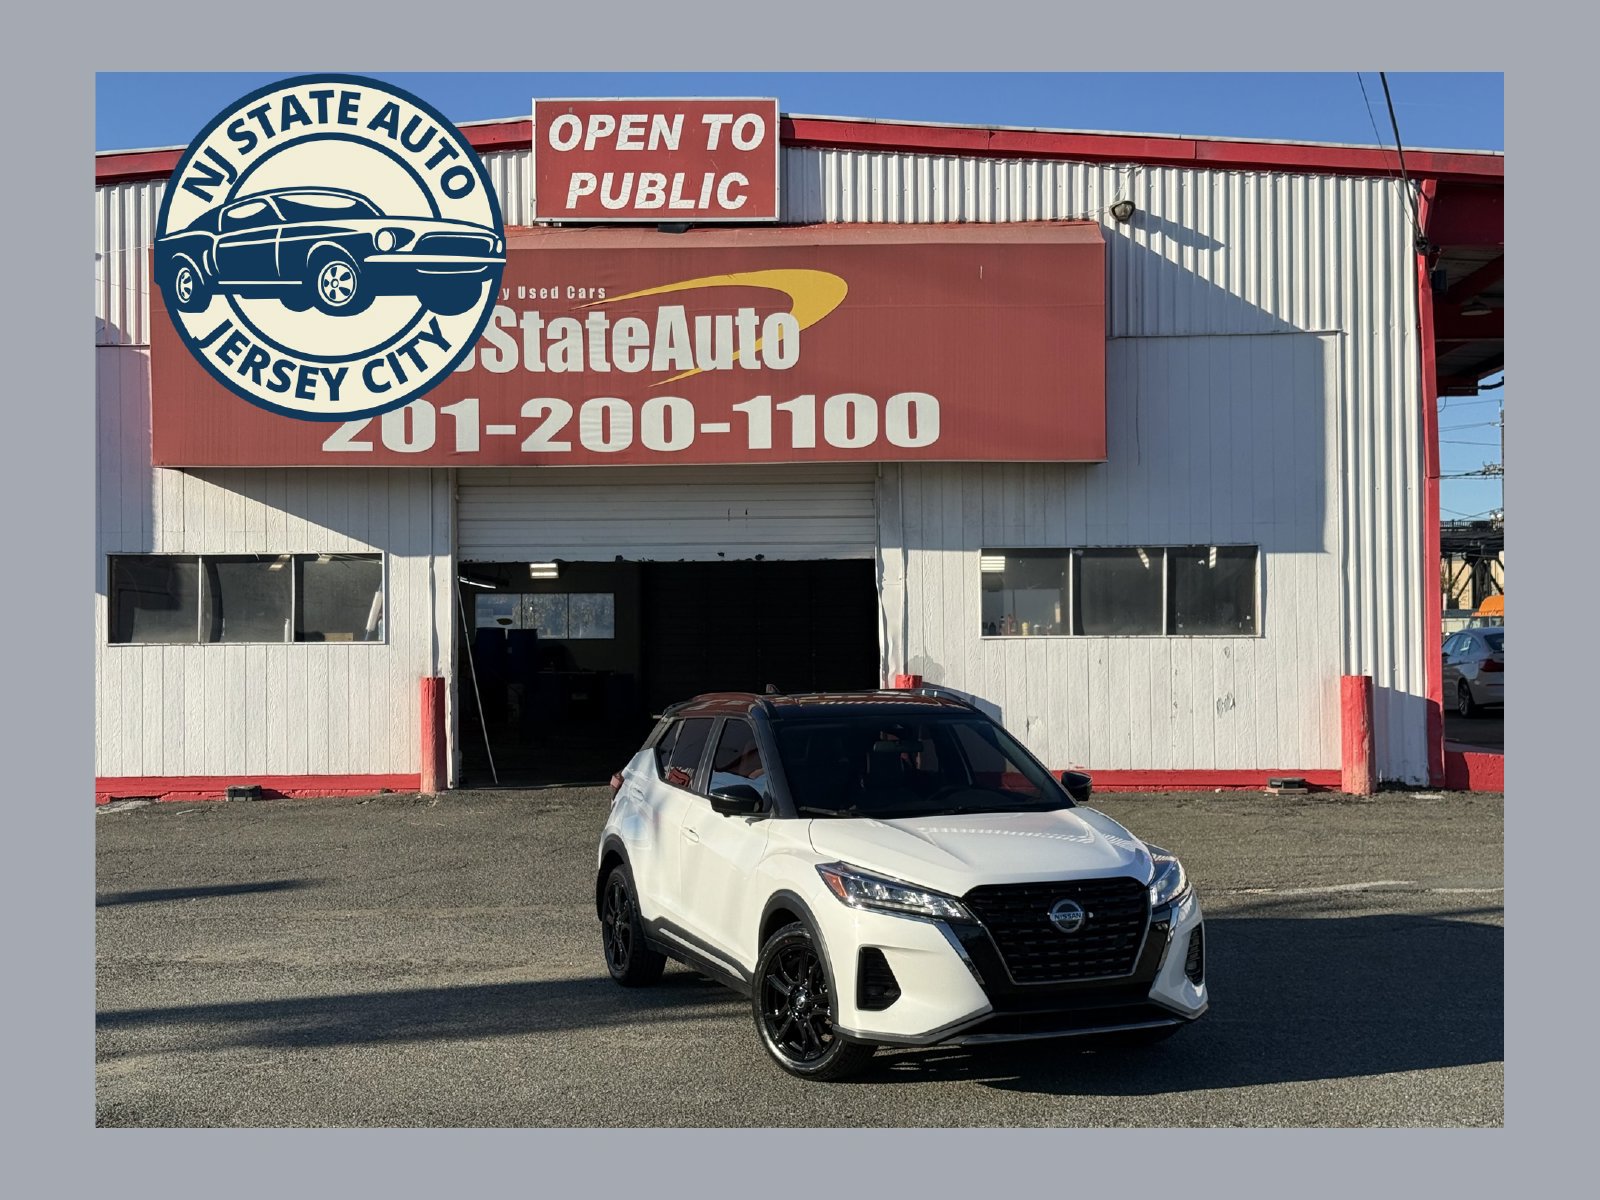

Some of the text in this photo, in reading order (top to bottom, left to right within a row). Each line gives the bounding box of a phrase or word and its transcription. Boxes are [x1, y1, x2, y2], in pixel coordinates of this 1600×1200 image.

[548, 113, 766, 152] OPEN TO
[565, 172, 750, 210] PUBLIC
[517, 285, 559, 300] Used
[567, 285, 606, 300] Cars
[322, 392, 940, 453] 201-200-1100
[1054, 911, 1082, 920] NISSAN
